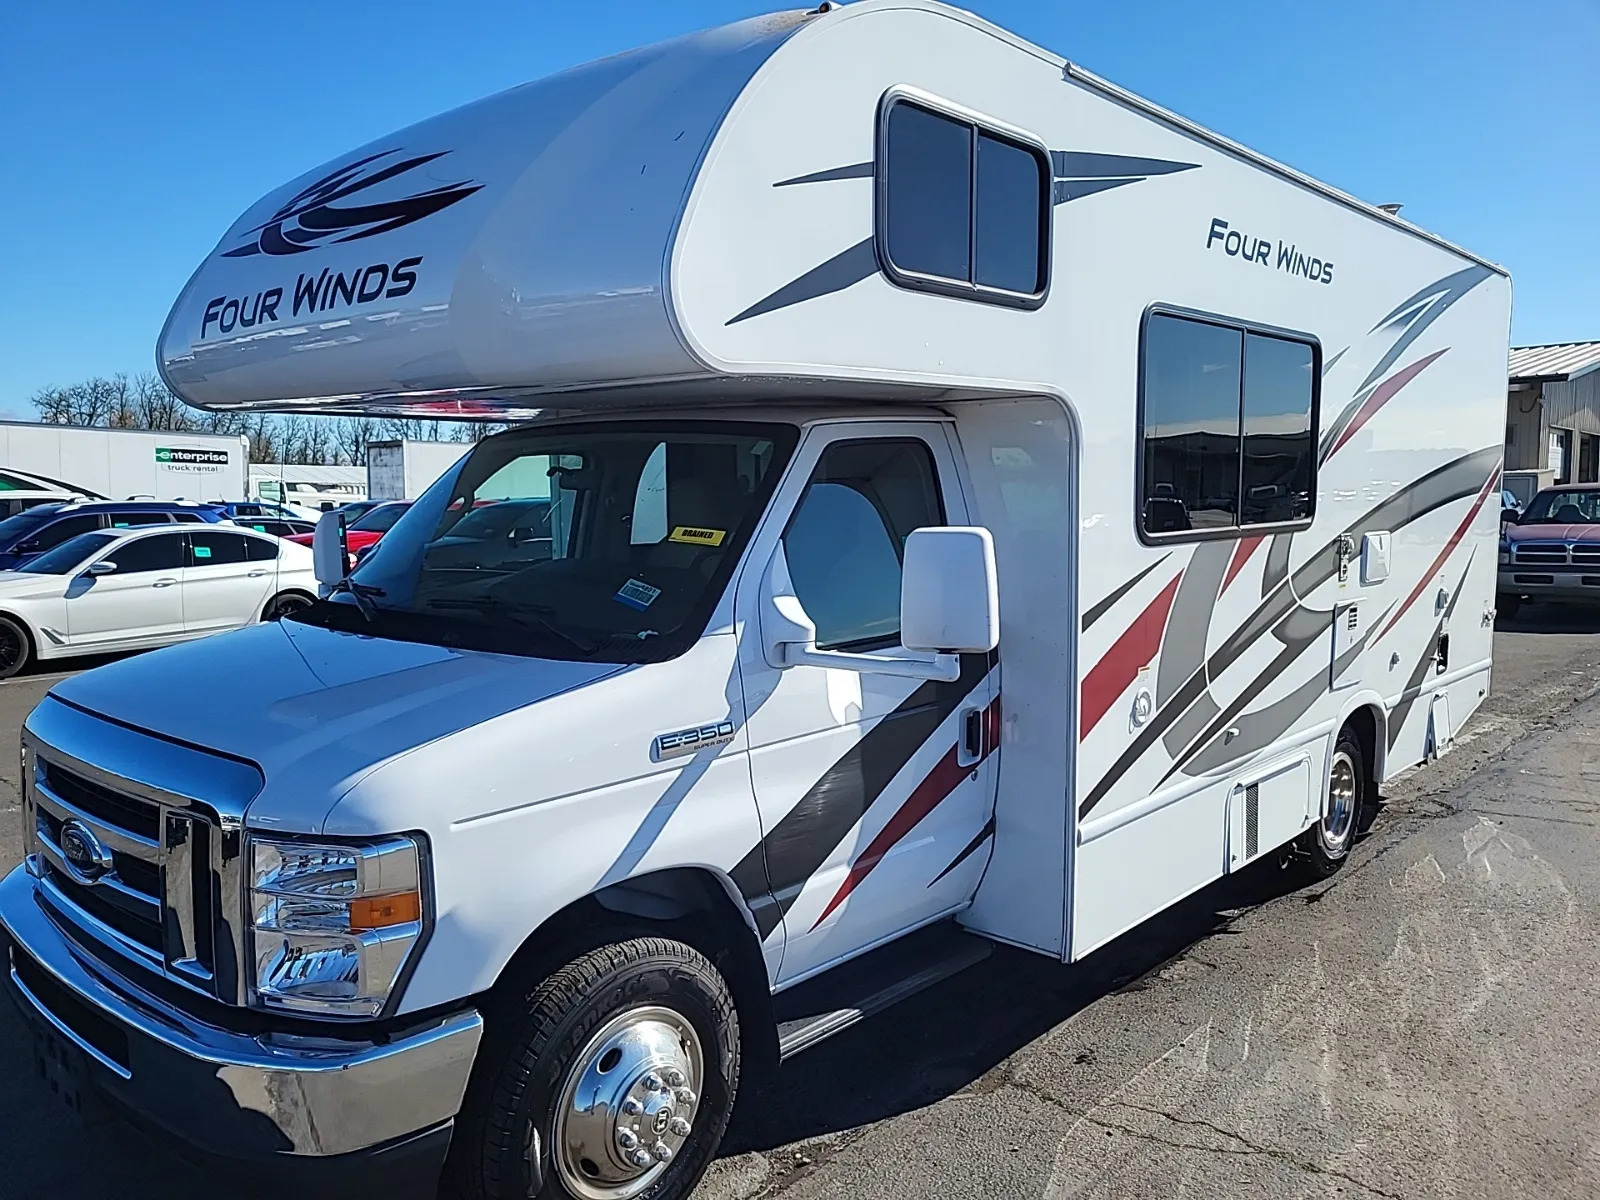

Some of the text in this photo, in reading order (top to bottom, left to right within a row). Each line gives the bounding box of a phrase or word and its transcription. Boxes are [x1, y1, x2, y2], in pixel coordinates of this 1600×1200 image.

[1206, 217, 1334, 285] FOUR WINDS
[201, 256, 424, 340] FOUR WINDS
[156, 451, 228, 462] enterprise
[168, 464, 218, 473] truck rental
[681, 529, 715, 539] DRAINED
[693, 740, 715, 750] SUPER
